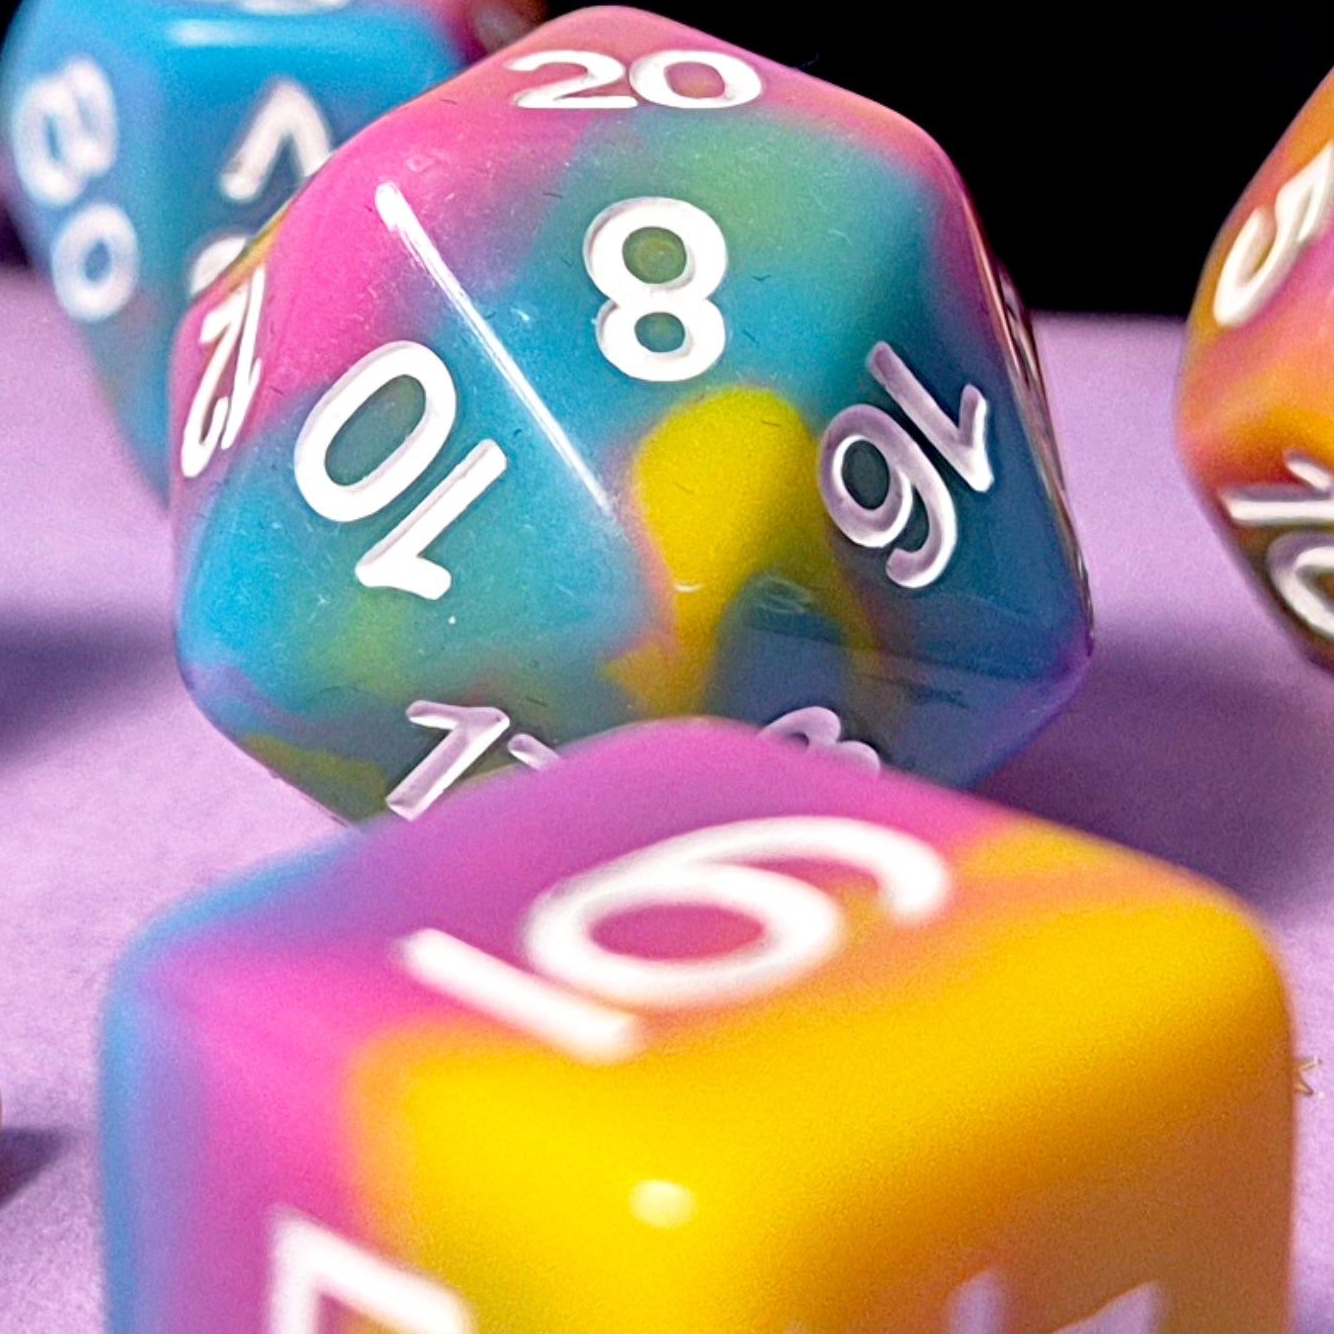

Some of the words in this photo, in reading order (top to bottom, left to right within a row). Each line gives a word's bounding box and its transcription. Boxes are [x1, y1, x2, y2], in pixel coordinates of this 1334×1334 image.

[509, 50, 762, 110] 20
[583, 196, 728, 382] 8
[294, 340, 509, 600] 10
[817, 341, 995, 589] 16
